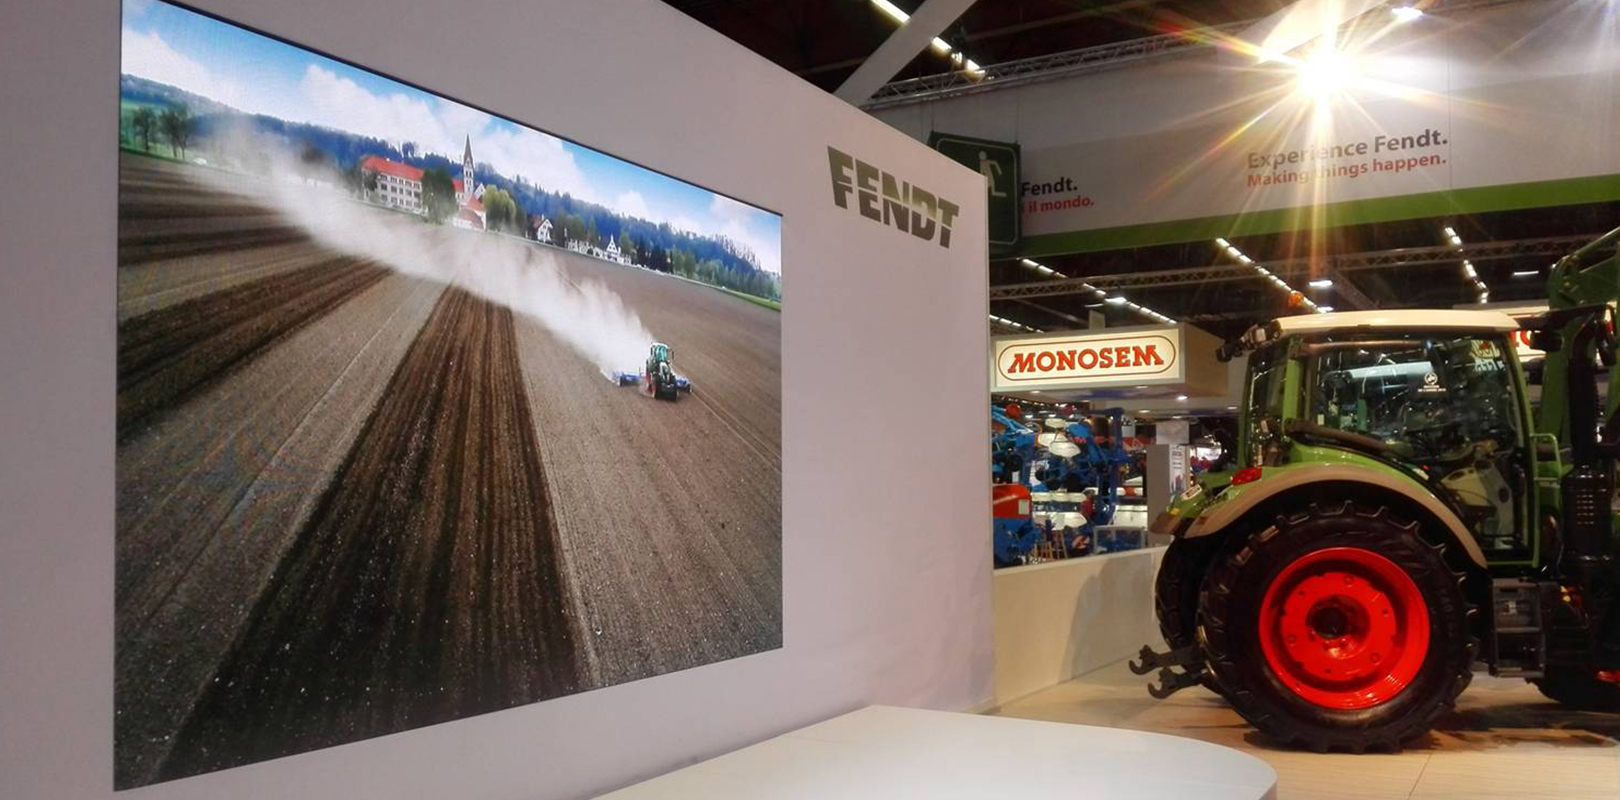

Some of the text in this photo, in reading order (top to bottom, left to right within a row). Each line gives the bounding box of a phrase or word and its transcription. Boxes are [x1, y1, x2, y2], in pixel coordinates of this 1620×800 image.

[1247, 128, 1448, 170] Experience Fendt.
[1247, 169, 1309, 187] Making
[1372, 153, 1447, 173] happen.
[827, 146, 960, 249] FENDT
[1021, 177, 1078, 196] Fendt.
[1041, 195, 1095, 211] mondo.
[1007, 345, 1164, 374] MONOSEM
